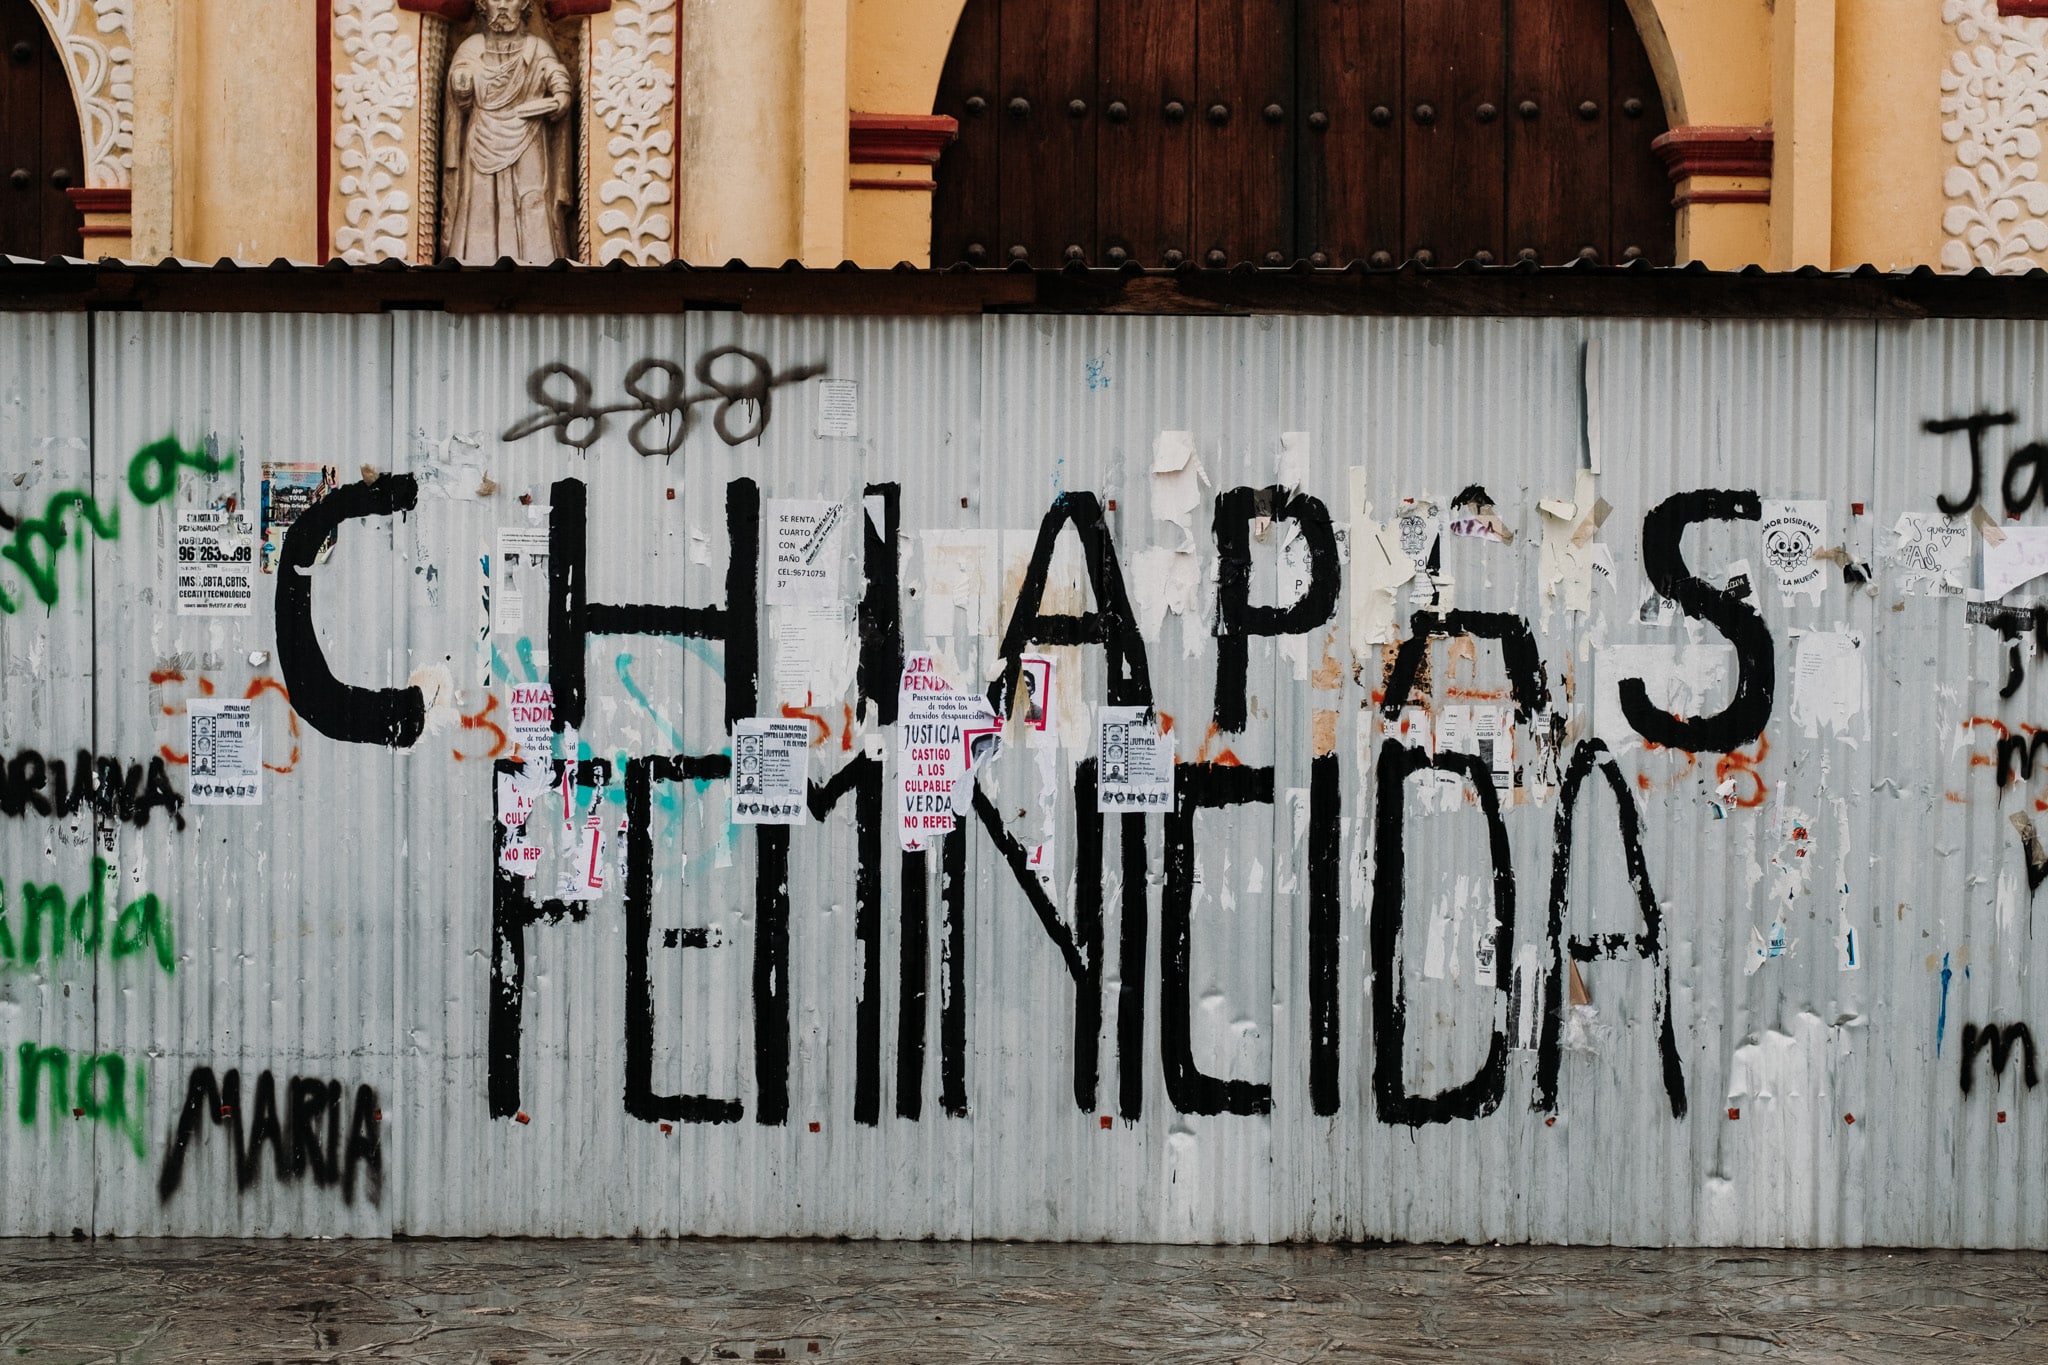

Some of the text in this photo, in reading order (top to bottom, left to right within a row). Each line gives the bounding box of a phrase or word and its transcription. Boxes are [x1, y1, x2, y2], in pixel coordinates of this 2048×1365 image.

[780, 515, 815, 523] SE RENTA
[780, 528, 811, 537] CUARTO
[1783, 517, 1820, 535] DISIDENTE
[1927, 526, 1967, 541] queremos
[778, 541, 796, 549] CON
[778, 554, 800, 563] BAÑO
[777, 580, 786, 588] 37
[207, 589, 251, 598] TECNOLÓGICO
[277, 472, 1775, 751] CHIAPAS
[958, 702, 968, 710] los
[904, 724, 961, 750] JUSTICIA
[911, 748, 951, 761] CASTIGO
[917, 763, 945, 776] A LOS
[0, 749, 186, 830] RIANA
[906, 795, 952, 813] VERDA
[904, 816, 919, 829] NO
[505, 847, 542, 861] NO REP
[487, 737, 1687, 1127] FEMINICIDA
[157, 1066, 384, 1208] MARIA
